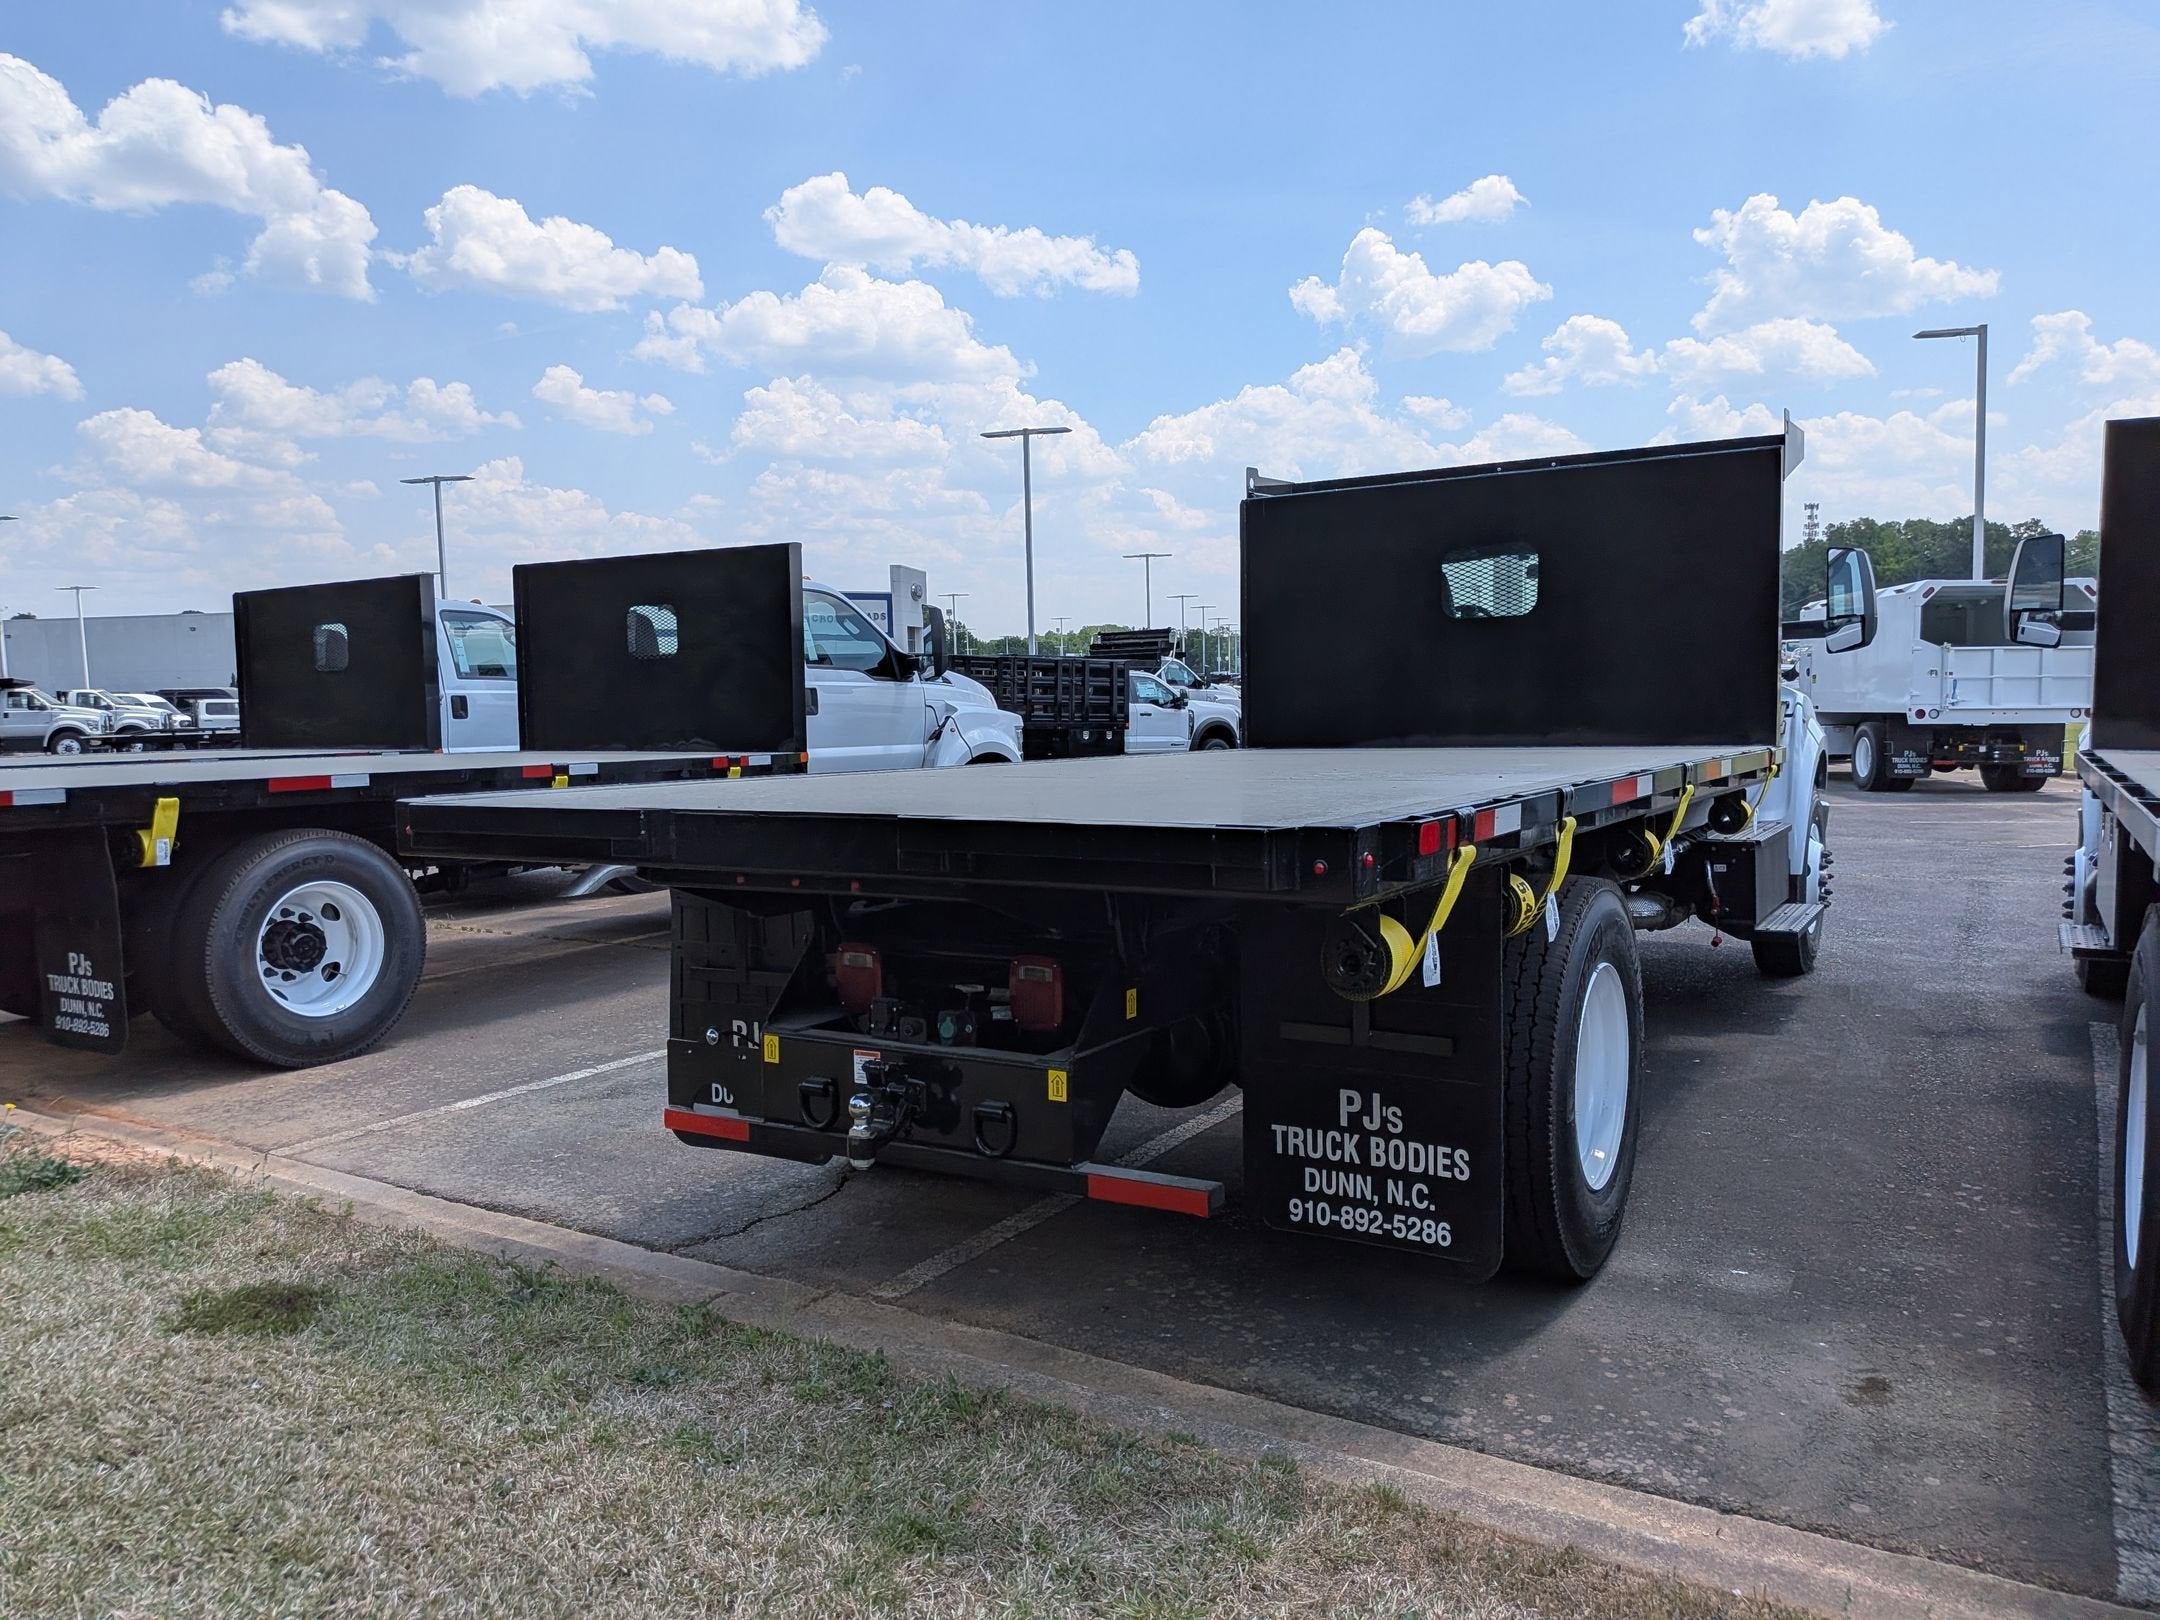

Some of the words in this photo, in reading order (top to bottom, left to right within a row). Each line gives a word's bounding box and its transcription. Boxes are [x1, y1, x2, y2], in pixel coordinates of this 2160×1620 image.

[47, 974, 80, 994] TRUCK
[81, 979, 114, 1000] BODIES
[60, 997, 87, 1018] DUNN,
[87, 1002, 105, 1018] N.C.
[55, 1016, 109, 1037] 910-892-5286
[711, 1083, 734, 1104] DU
[1271, 1123, 1361, 1165] TRUCK
[1370, 1136, 1471, 1182] BODIES
[1304, 1167, 1380, 1207] DUNN,
[1387, 1178, 1437, 1212] N.C.
[1288, 1198, 1453, 1248] 910-892-5286
